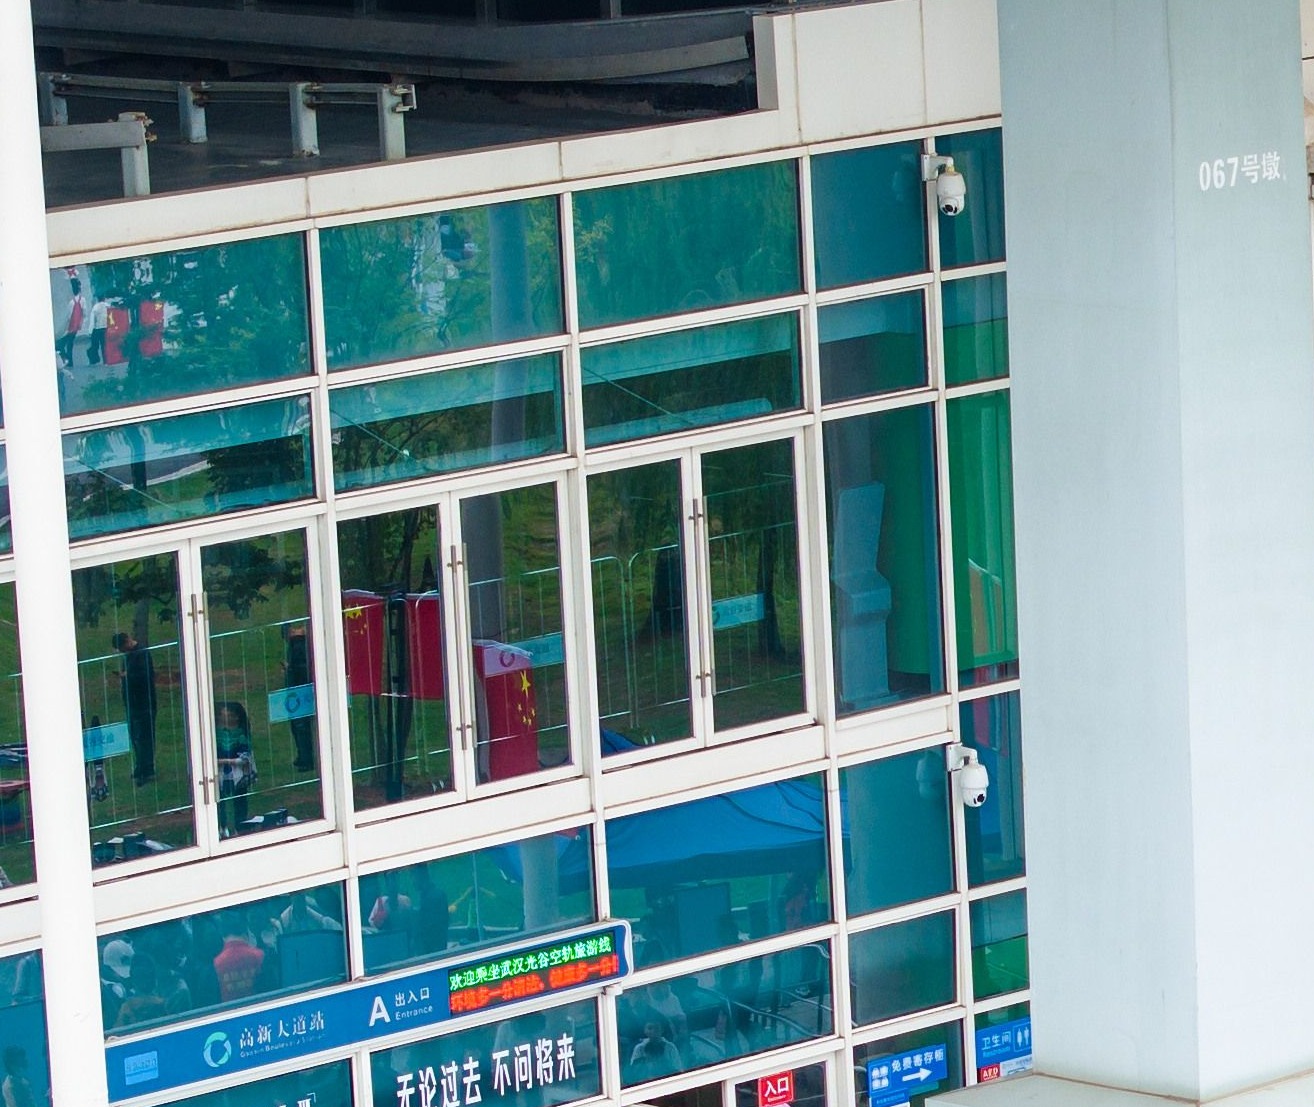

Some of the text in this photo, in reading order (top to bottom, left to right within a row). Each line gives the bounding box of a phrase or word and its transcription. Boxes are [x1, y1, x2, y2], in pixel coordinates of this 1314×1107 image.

[1199, 151, 1281, 191] 067号墩
[449, 936, 612, 990] 欢迎乘坐武汉光谷空轨旅游线
[369, 996, 391, 1027] A
[395, 986, 430, 1007] 出入口
[395, 1004, 433, 1021] Entrance
[239, 1010, 325, 1049] 高新大道站
[982, 1031, 1012, 1050] 卫生间
[492, 1032, 577, 1097] 不问将来
[764, 1076, 789, 1098] 入口
